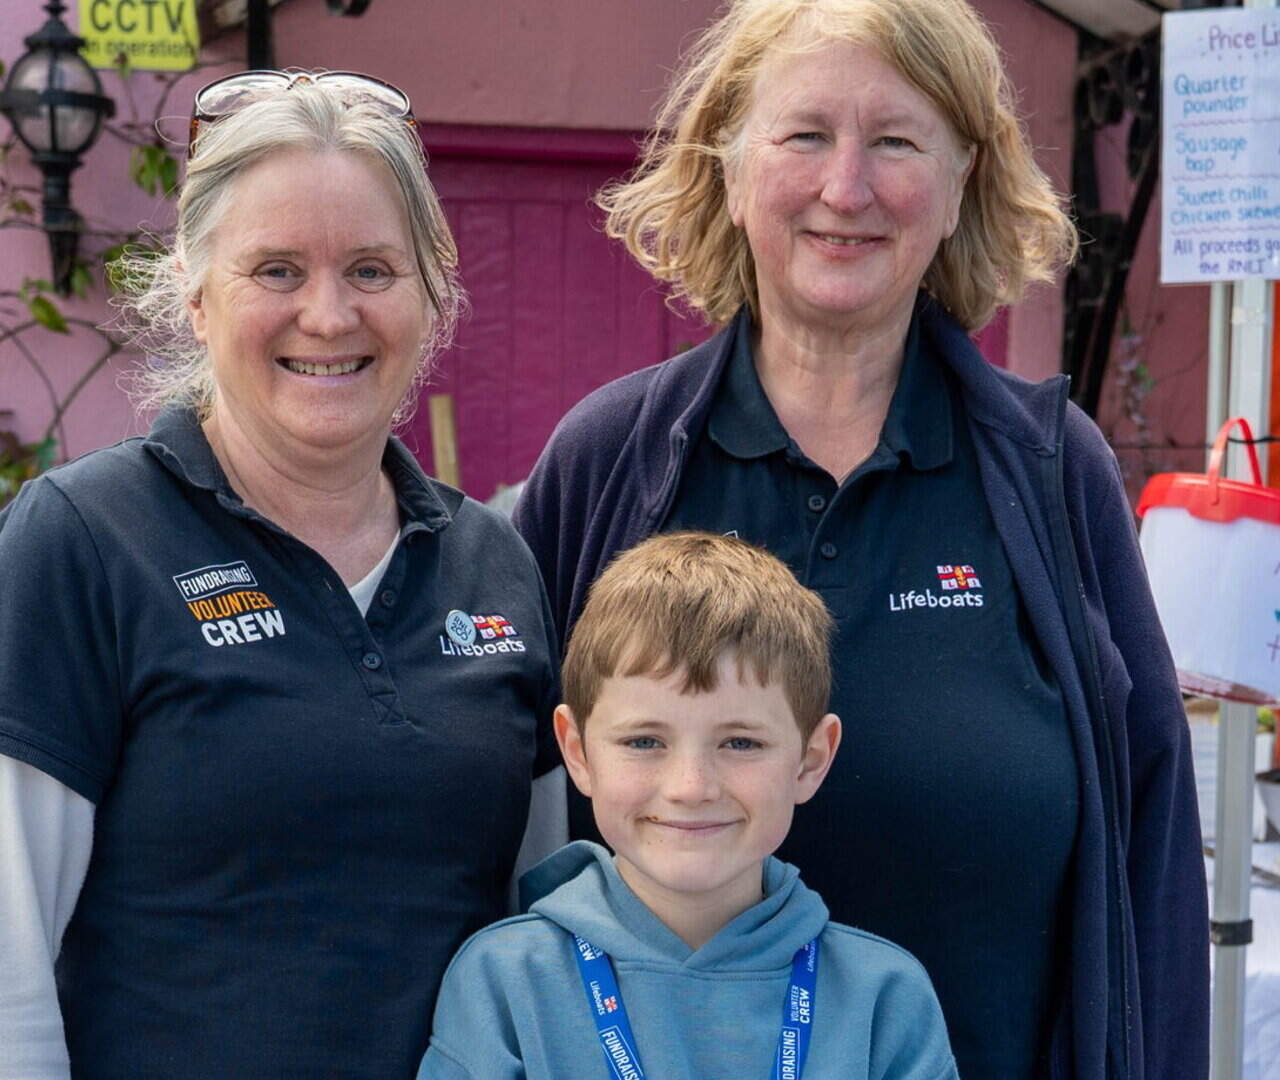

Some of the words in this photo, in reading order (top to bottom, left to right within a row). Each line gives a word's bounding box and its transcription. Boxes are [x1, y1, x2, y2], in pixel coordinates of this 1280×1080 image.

[89, 0, 184, 33] CCTV
[1209, 26, 1256, 50] Price
[1174, 74, 1247, 96] Quarter
[1183, 96, 1248, 118] pounder
[1176, 132, 1247, 160] Sausage
[1185, 156, 1215, 173] bap
[1176, 186, 1225, 207] Sweet
[1173, 238, 1193, 255] All
[1199, 236, 1261, 258] proceeds
[180, 566, 251, 597] FUNDRAISING
[187, 591, 276, 621] VOLUNTEER
[889, 588, 984, 611] Lifeboats
[201, 609, 286, 647] CREW
[589, 980, 606, 1016] Lifeboats
[790, 985, 800, 1022] VOLUNTEER
[799, 988, 811, 1024] CREW
